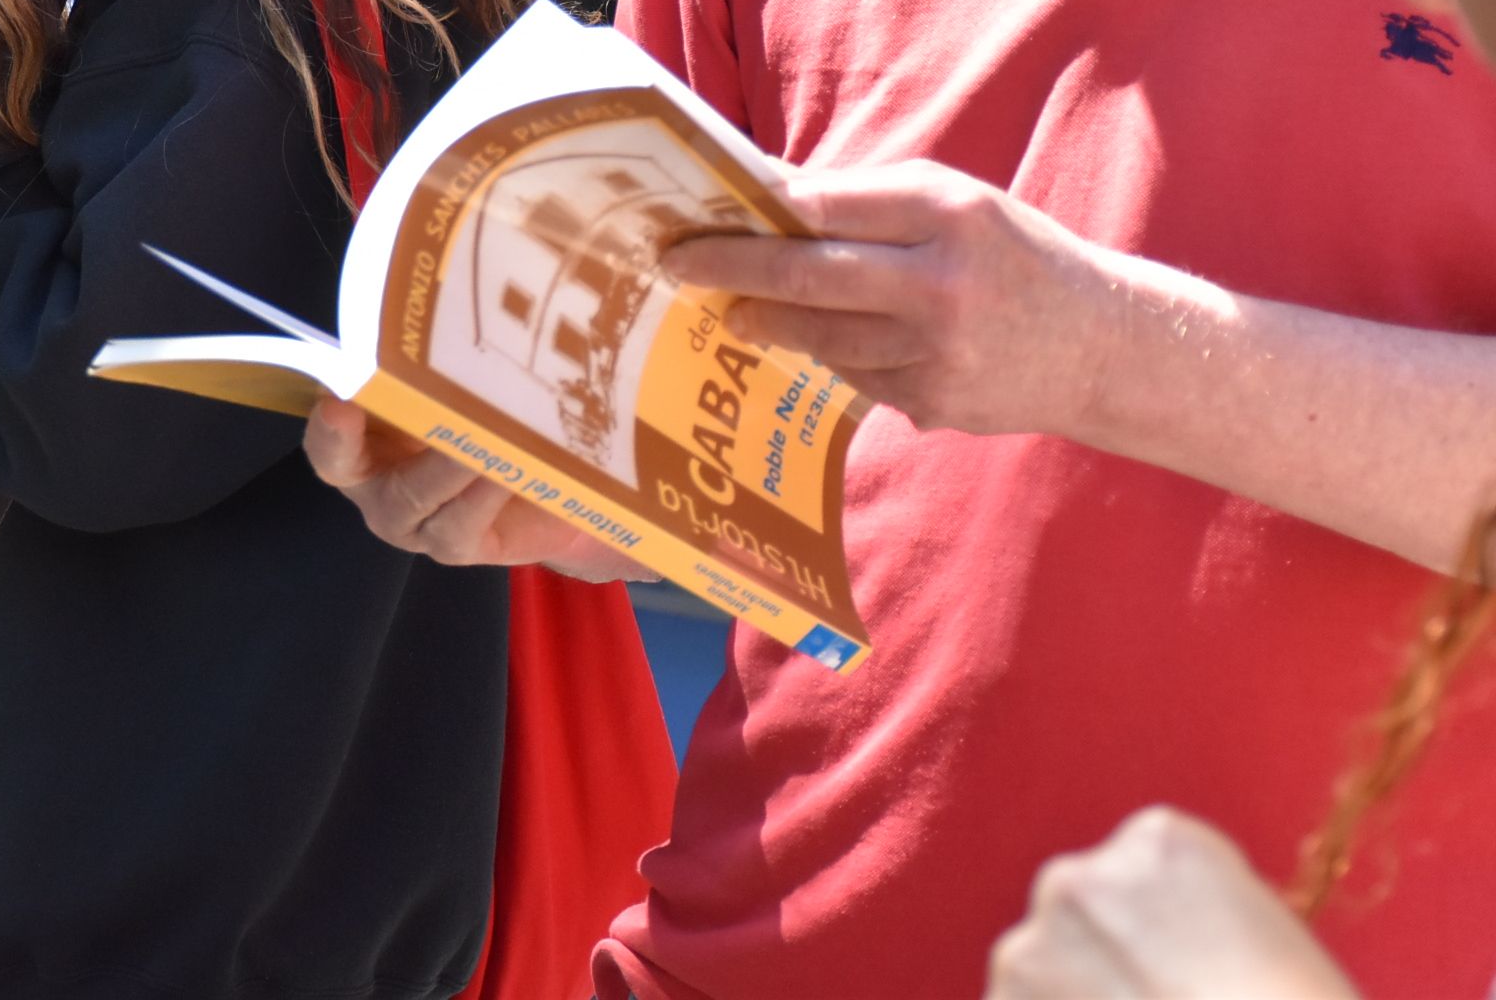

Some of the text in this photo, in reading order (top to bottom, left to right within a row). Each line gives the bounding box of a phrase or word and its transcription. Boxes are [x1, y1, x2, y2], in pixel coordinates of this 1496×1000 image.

[401, 251, 436, 363] ANTONIO
[425, 142, 507, 243] SANCHIS
[689, 305, 721, 354] del
[425, 424, 643, 549] Historia del Cabanyal
[688, 341, 768, 507] CABA
[762, 371, 811, 498] Poble Nou
[657, 478, 835, 609] Historia
